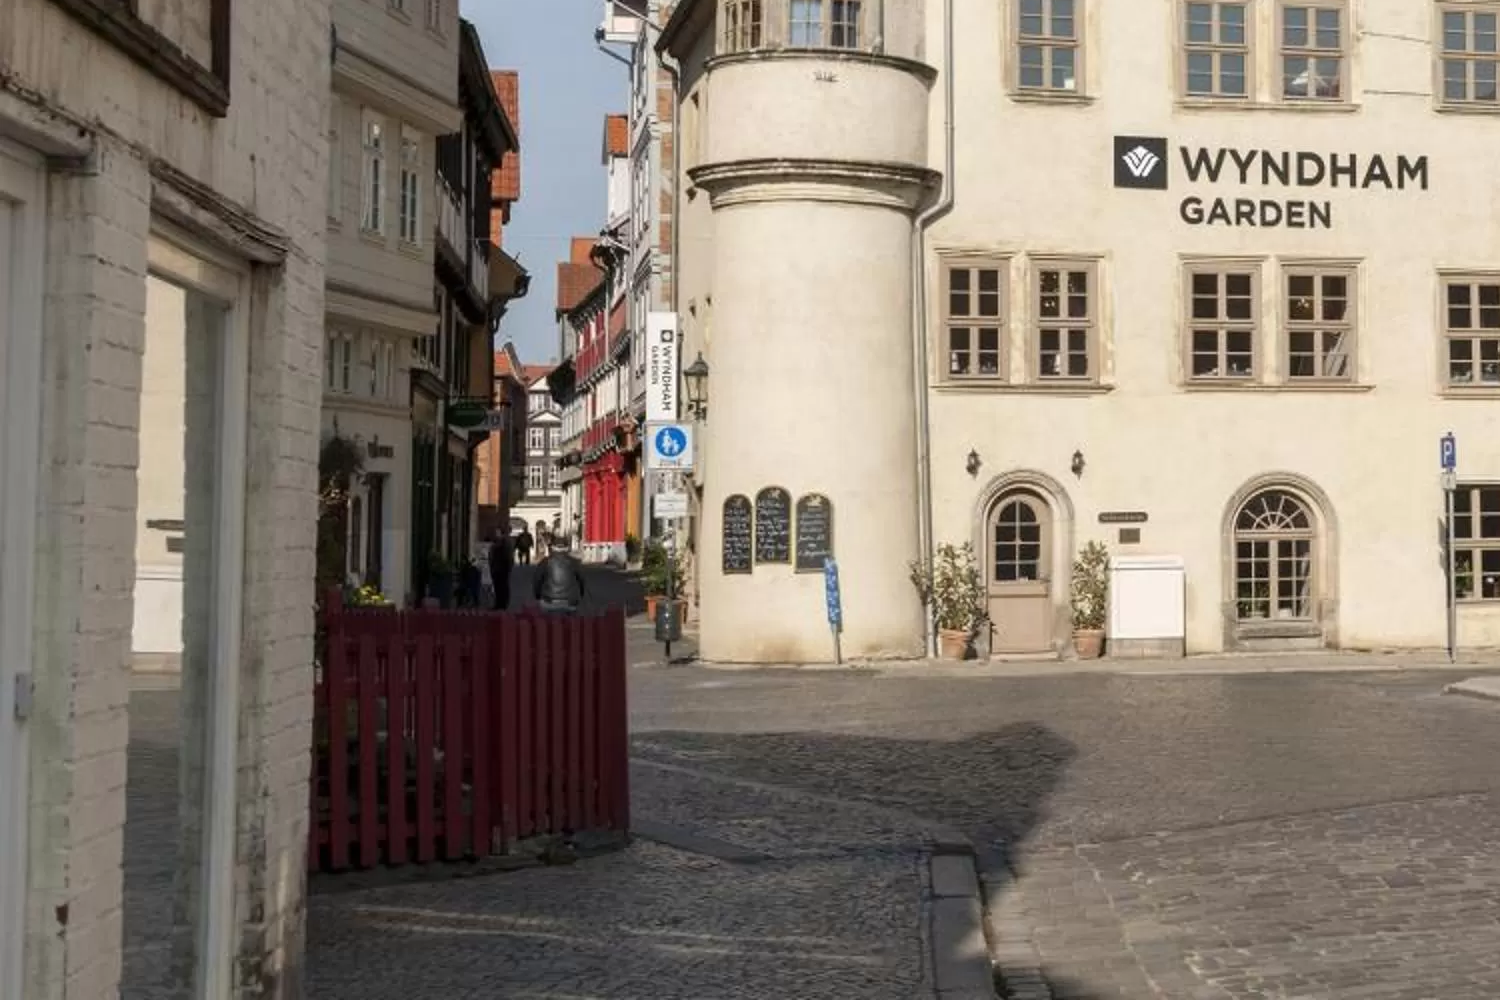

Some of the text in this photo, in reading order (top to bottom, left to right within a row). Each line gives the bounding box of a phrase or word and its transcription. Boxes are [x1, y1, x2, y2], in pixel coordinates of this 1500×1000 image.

[1179, 145, 1428, 191] WYNDHAM
[1179, 196, 1331, 229] GARDEN
[661, 345, 673, 411] WYNDHAM
[1443, 440, 1453, 465] P
